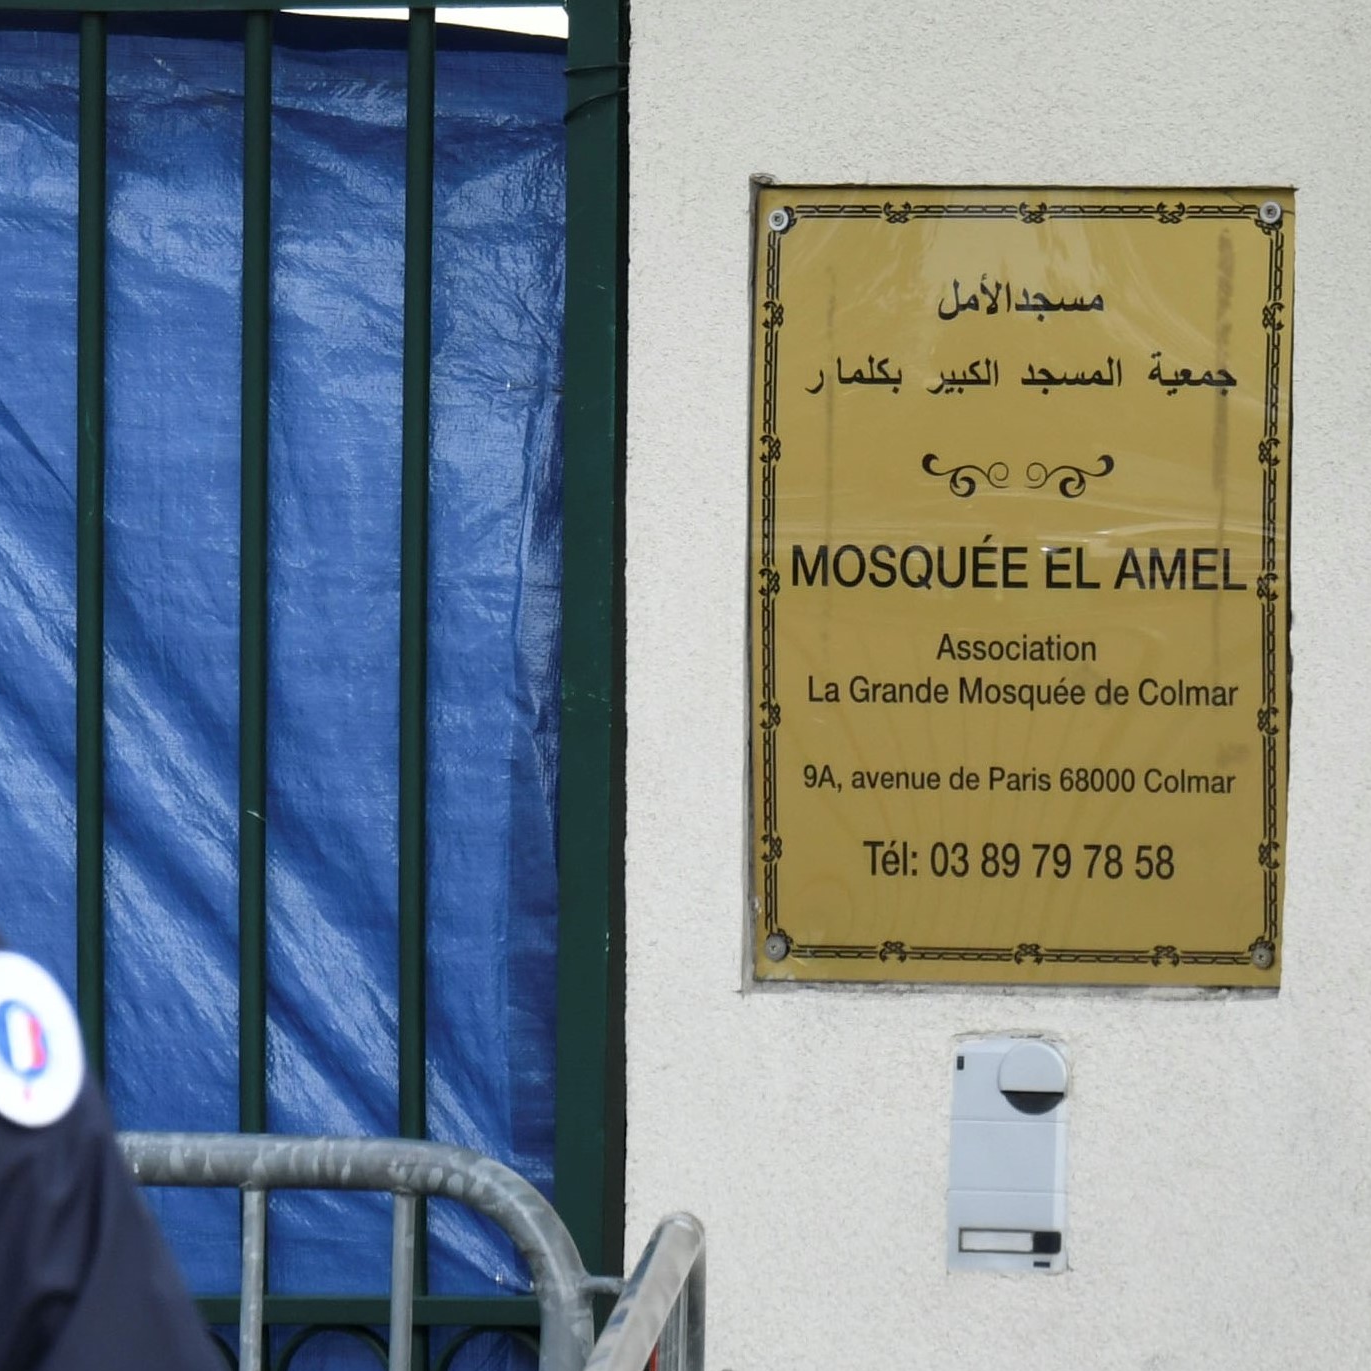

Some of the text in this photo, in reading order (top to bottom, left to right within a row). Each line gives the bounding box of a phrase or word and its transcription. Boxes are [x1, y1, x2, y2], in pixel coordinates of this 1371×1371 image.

[926, 357, 999, 395] الكبير
[1020, 355, 1123, 396] المسجد
[1147, 350, 1238, 397] جمعية
[791, 534, 1248, 591] MOSQUÉE EL AMEL
[936, 632, 1097, 662] Association
[808, 675, 1239, 712] La Grande Mosquée de Colmar
[803, 763, 1237, 794] 9A, avenue de Paris 68000 Colmar
[862, 839, 1175, 881] Tél: 03 89 79 78 58
